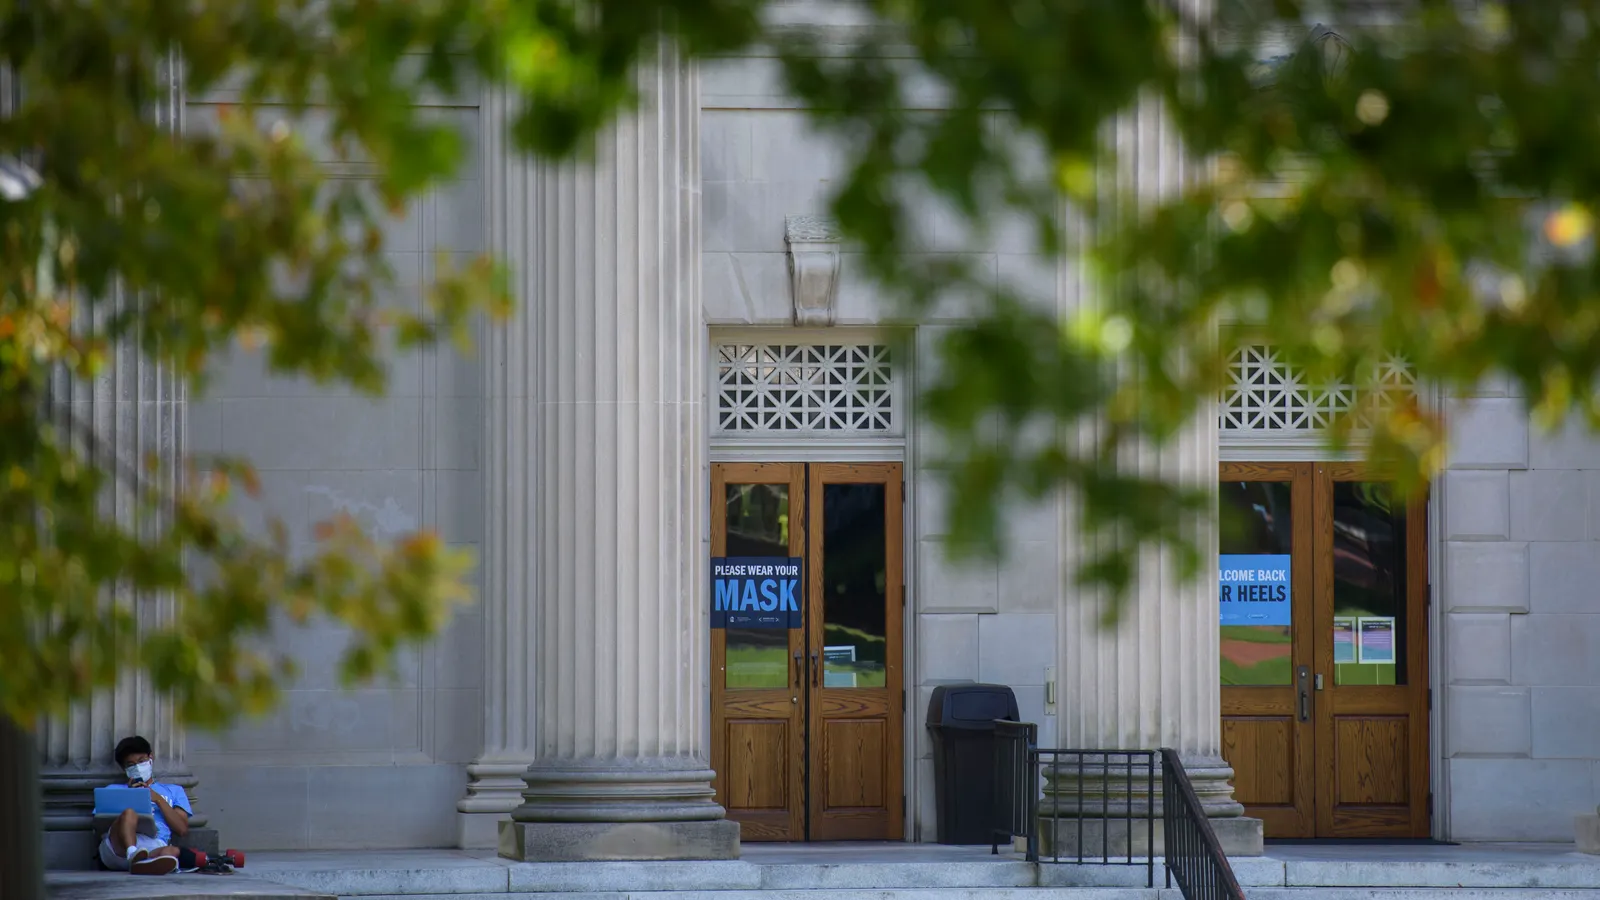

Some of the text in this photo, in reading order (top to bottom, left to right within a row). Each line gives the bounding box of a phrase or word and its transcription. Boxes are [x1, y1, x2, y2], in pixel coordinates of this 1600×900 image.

[715, 565, 798, 576] PLEASE WEAR YOUR
[1219, 569, 1286, 582] LCOME BACK
[715, 578, 799, 612] MASK
[1219, 585, 1287, 603] R HEELS
